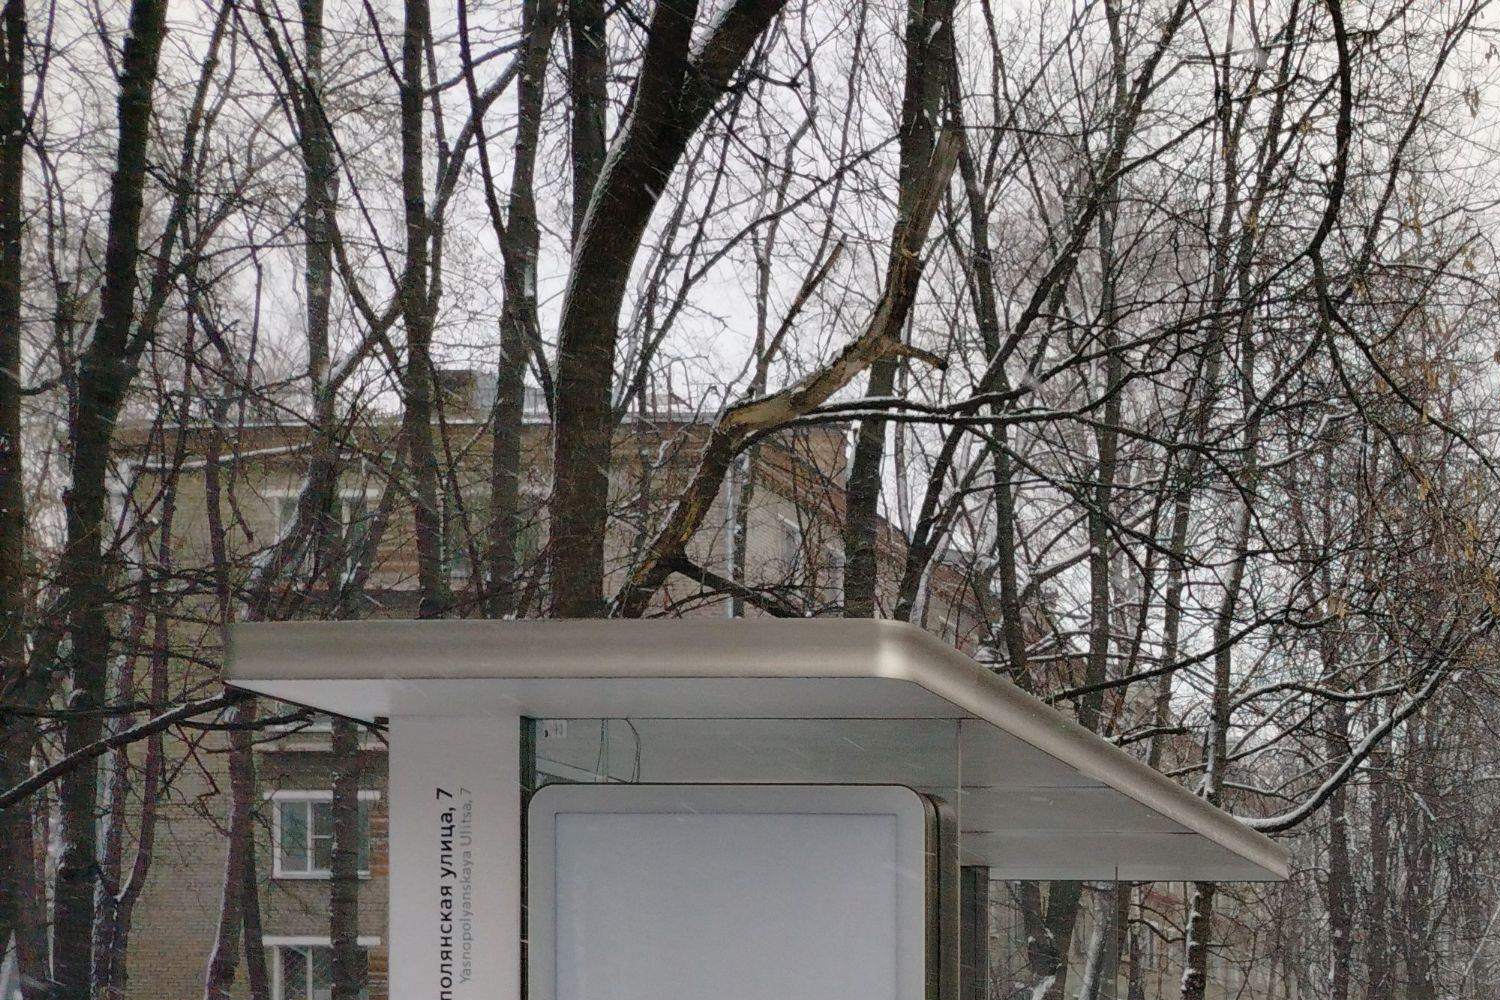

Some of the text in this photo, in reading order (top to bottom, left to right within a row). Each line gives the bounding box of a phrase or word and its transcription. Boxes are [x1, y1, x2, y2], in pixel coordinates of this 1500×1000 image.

[436, 787, 453, 800] 7
[440, 807, 457, 878] улица,
[460, 787, 474, 984] Yasnopolyanskaya Ulitsa, 7
